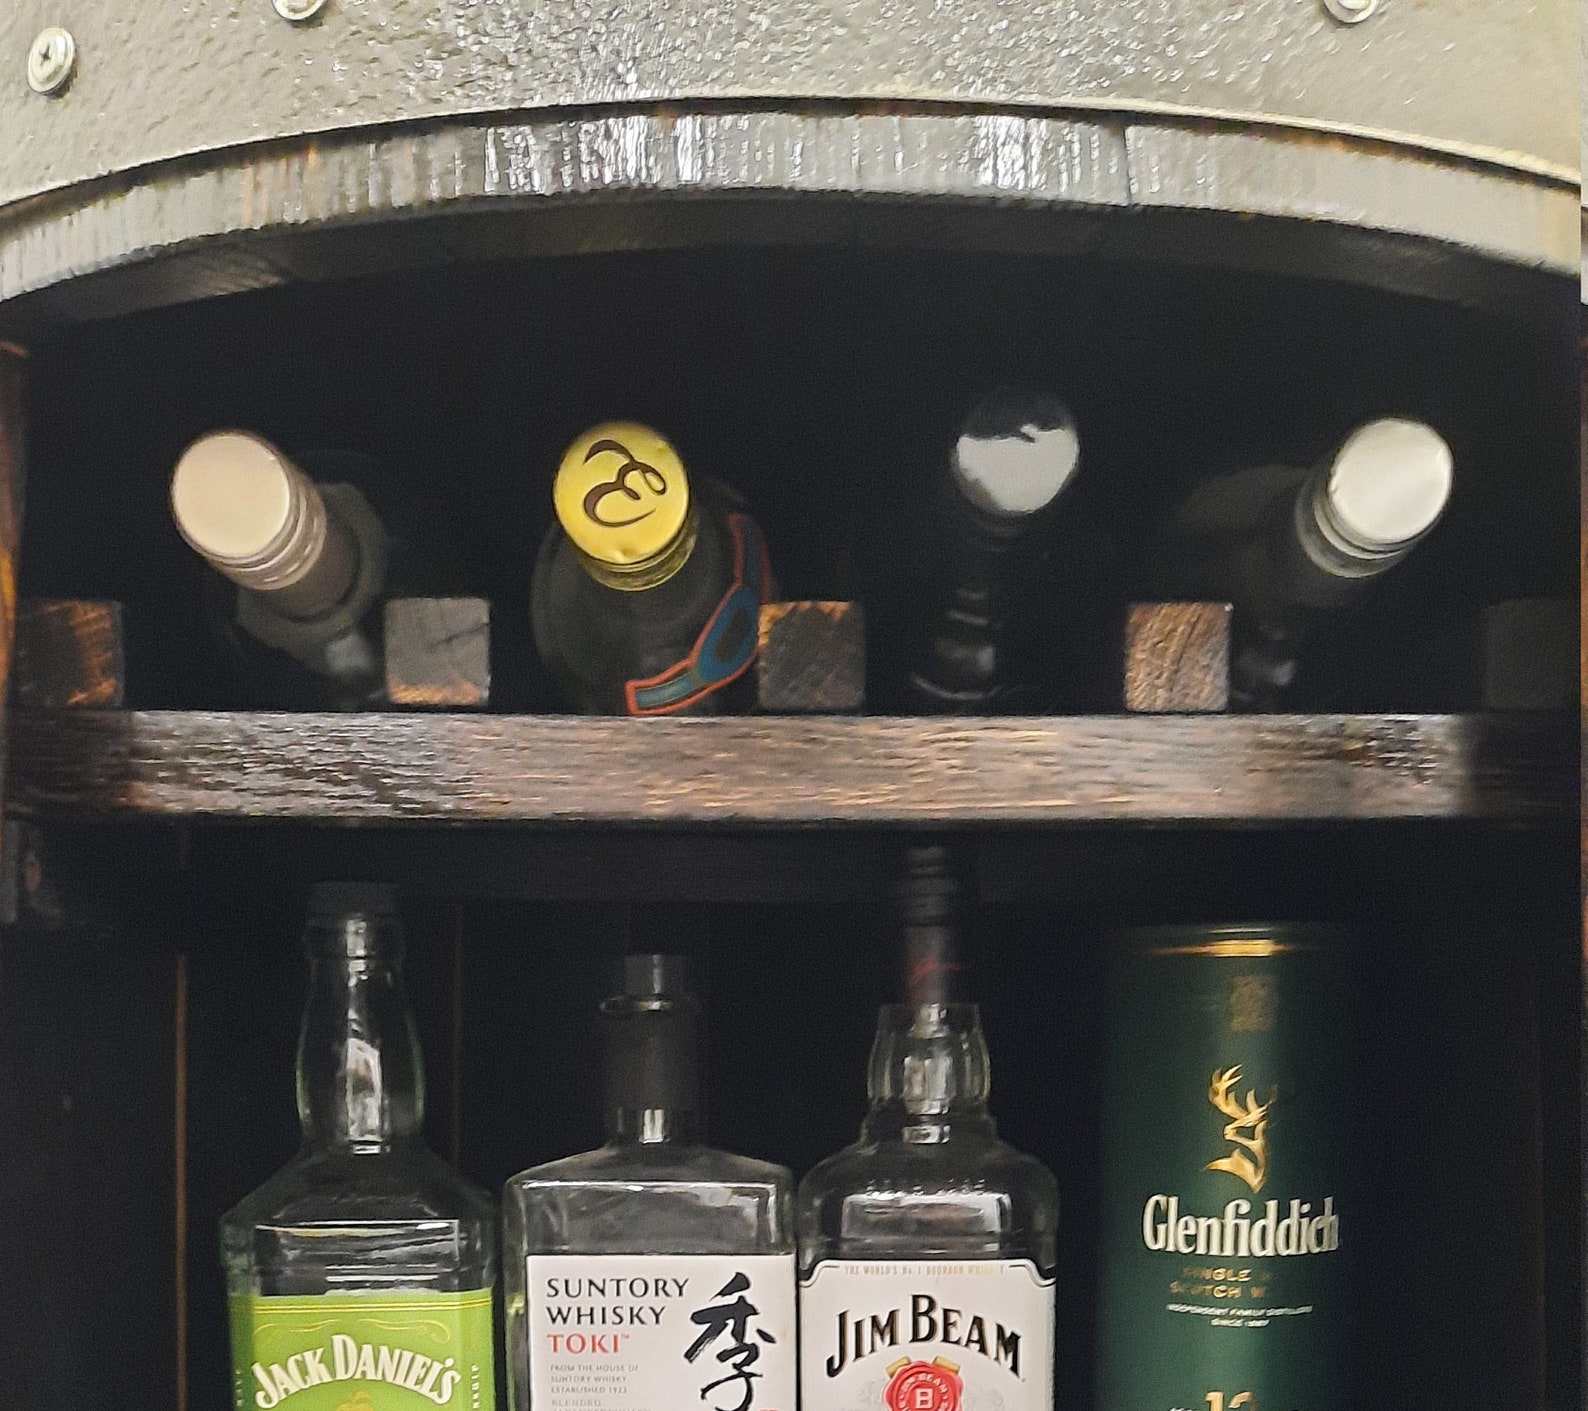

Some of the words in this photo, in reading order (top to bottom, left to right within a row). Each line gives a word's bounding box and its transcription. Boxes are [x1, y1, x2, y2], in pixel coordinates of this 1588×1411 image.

[1142, 1193, 1339, 1257] Glenfiddich
[845, 1264, 859, 1275] THE
[546, 1277, 690, 1298] SUNTORY
[546, 1305, 667, 1326] WHISKY
[825, 1308, 900, 1378] JIM
[909, 1294, 1024, 1380] BEAM
[252, 1347, 332, 1409] JACK
[331, 1334, 462, 1405] DANIEL'S
[550, 1364, 575, 1372] FROM
[577, 1364, 592, 1372] THE
[596, 1364, 625, 1372] HOUSE
[628, 1364, 639, 1372] OF
[551, 1375, 591, 1383] SUNTORY
[593, 1375, 628, 1383] WHISKY
[919, 1373, 948, 1394] BEAM
[551, 1386, 606, 1394] ESTABLISHED
[915, 1388, 934, 1409] B
